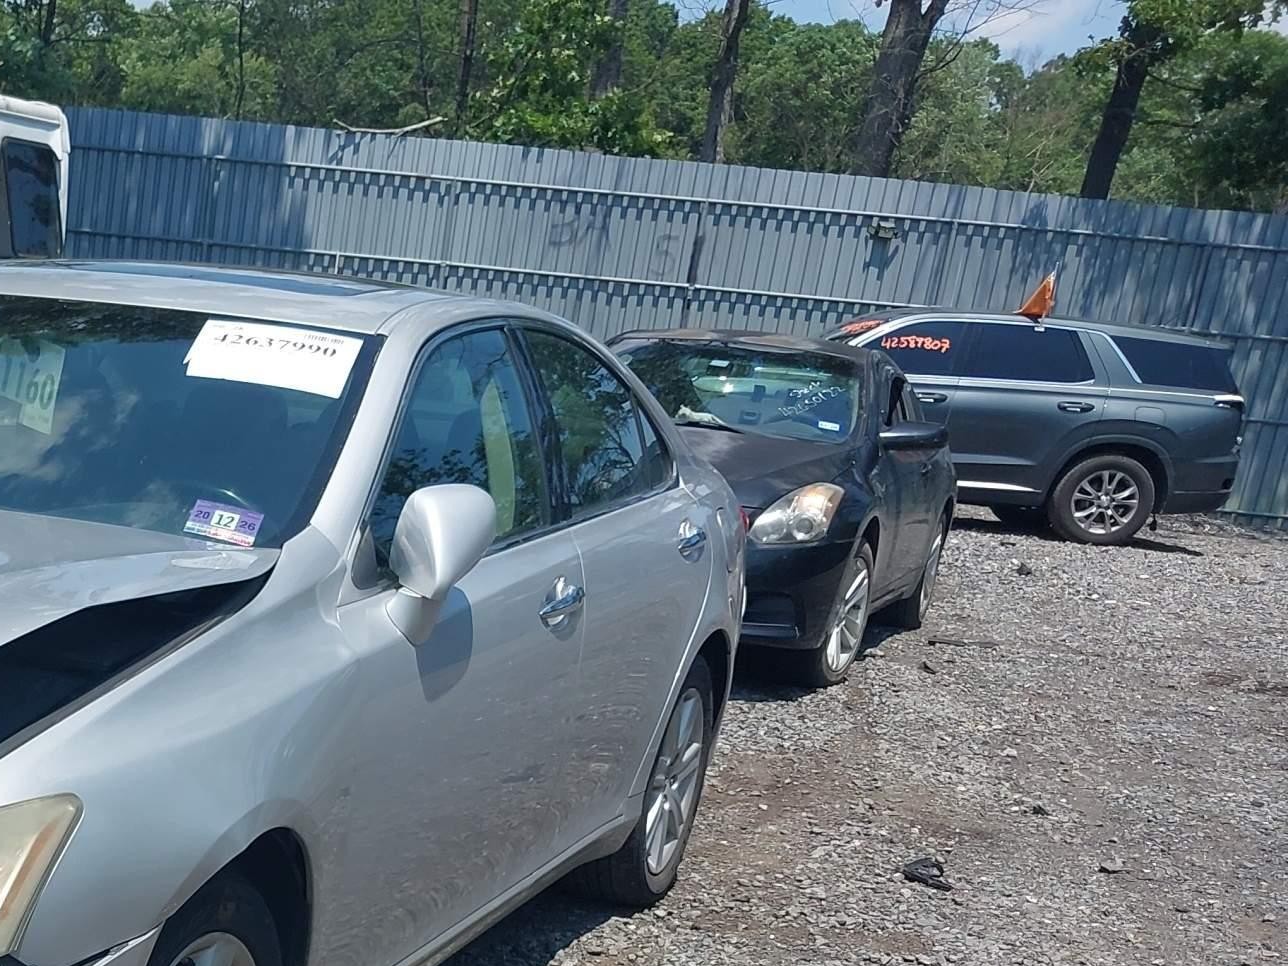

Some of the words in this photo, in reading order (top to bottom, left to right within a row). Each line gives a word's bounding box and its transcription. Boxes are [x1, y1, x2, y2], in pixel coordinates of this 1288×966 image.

[214, 333, 337, 357] 42637990
[195, 510, 210, 520] 20
[214, 513, 235, 528] 12
[239, 520, 256, 532] 26
